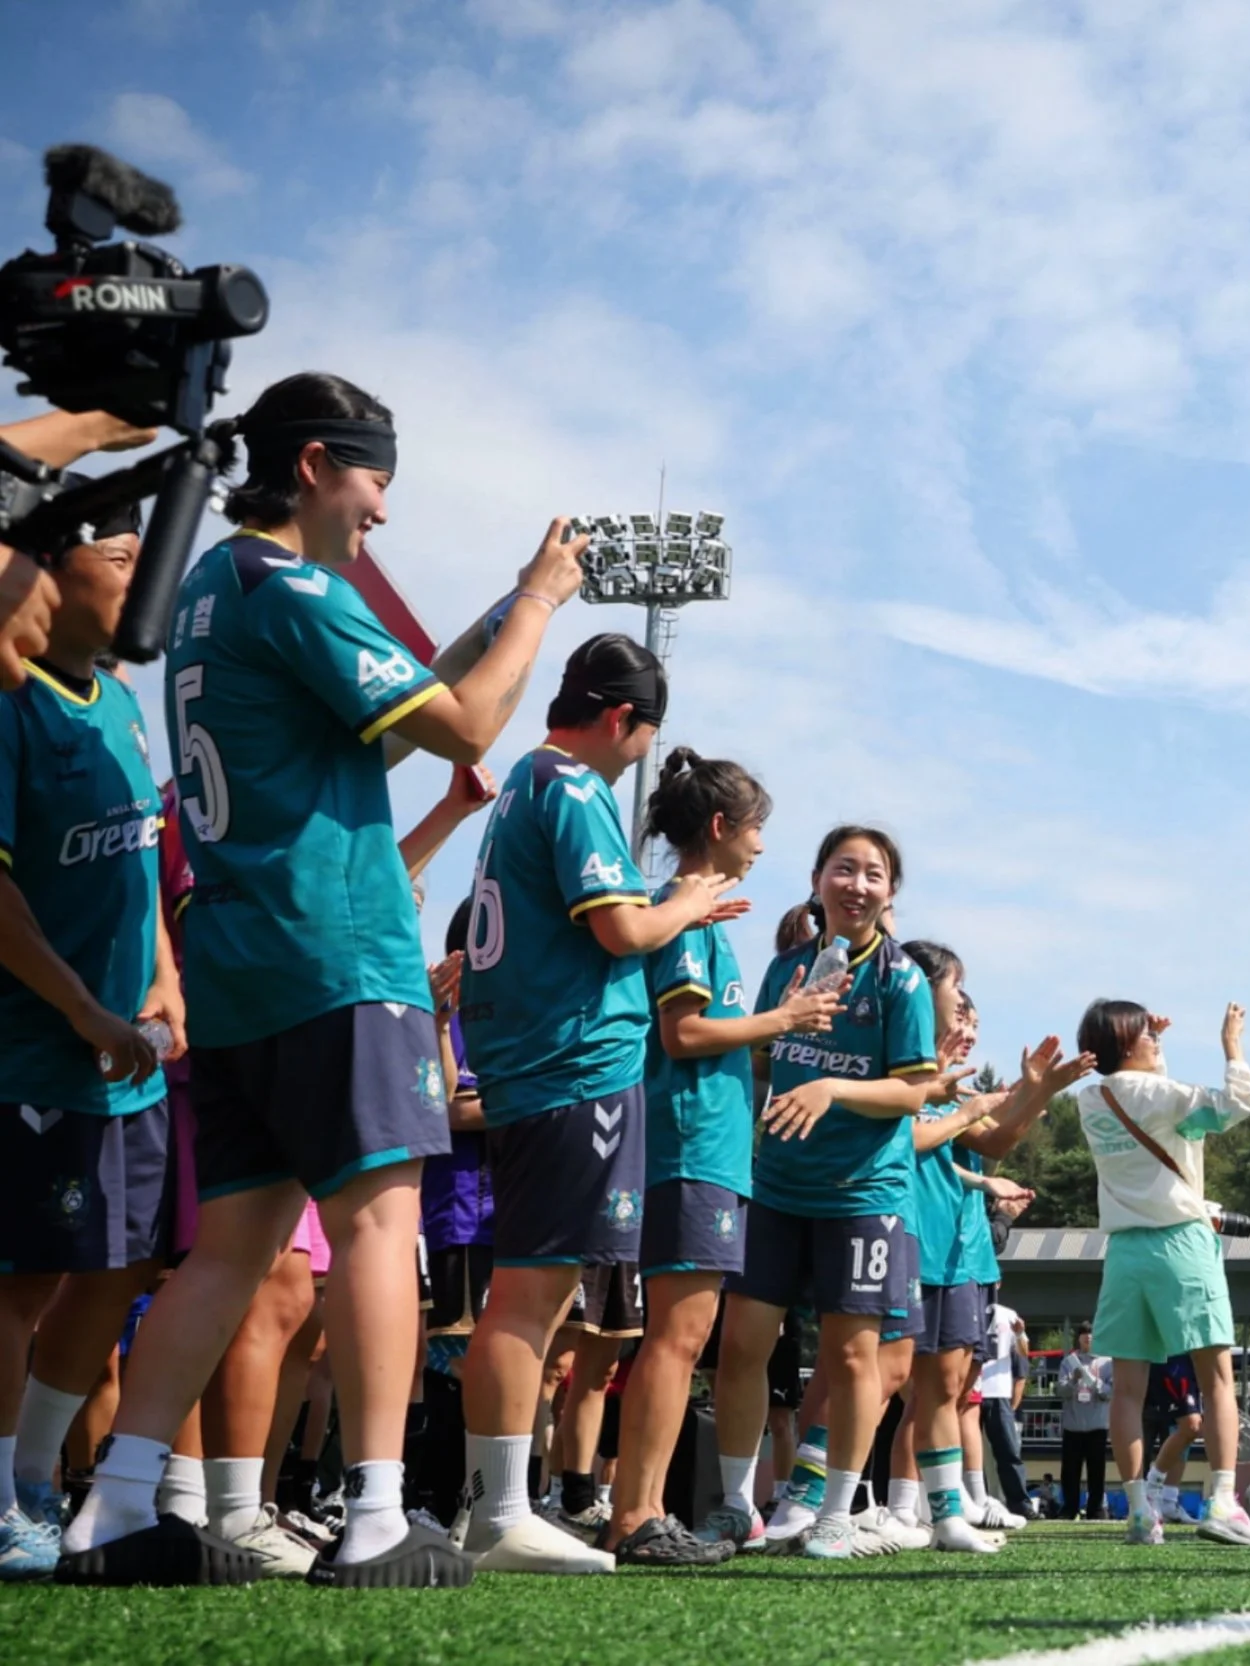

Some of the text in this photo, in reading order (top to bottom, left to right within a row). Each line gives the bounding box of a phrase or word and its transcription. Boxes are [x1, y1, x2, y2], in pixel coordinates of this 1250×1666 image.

[73, 283, 166, 311] RONIN
[174, 665, 230, 843] 5
[850, 1237, 889, 1281] 18
